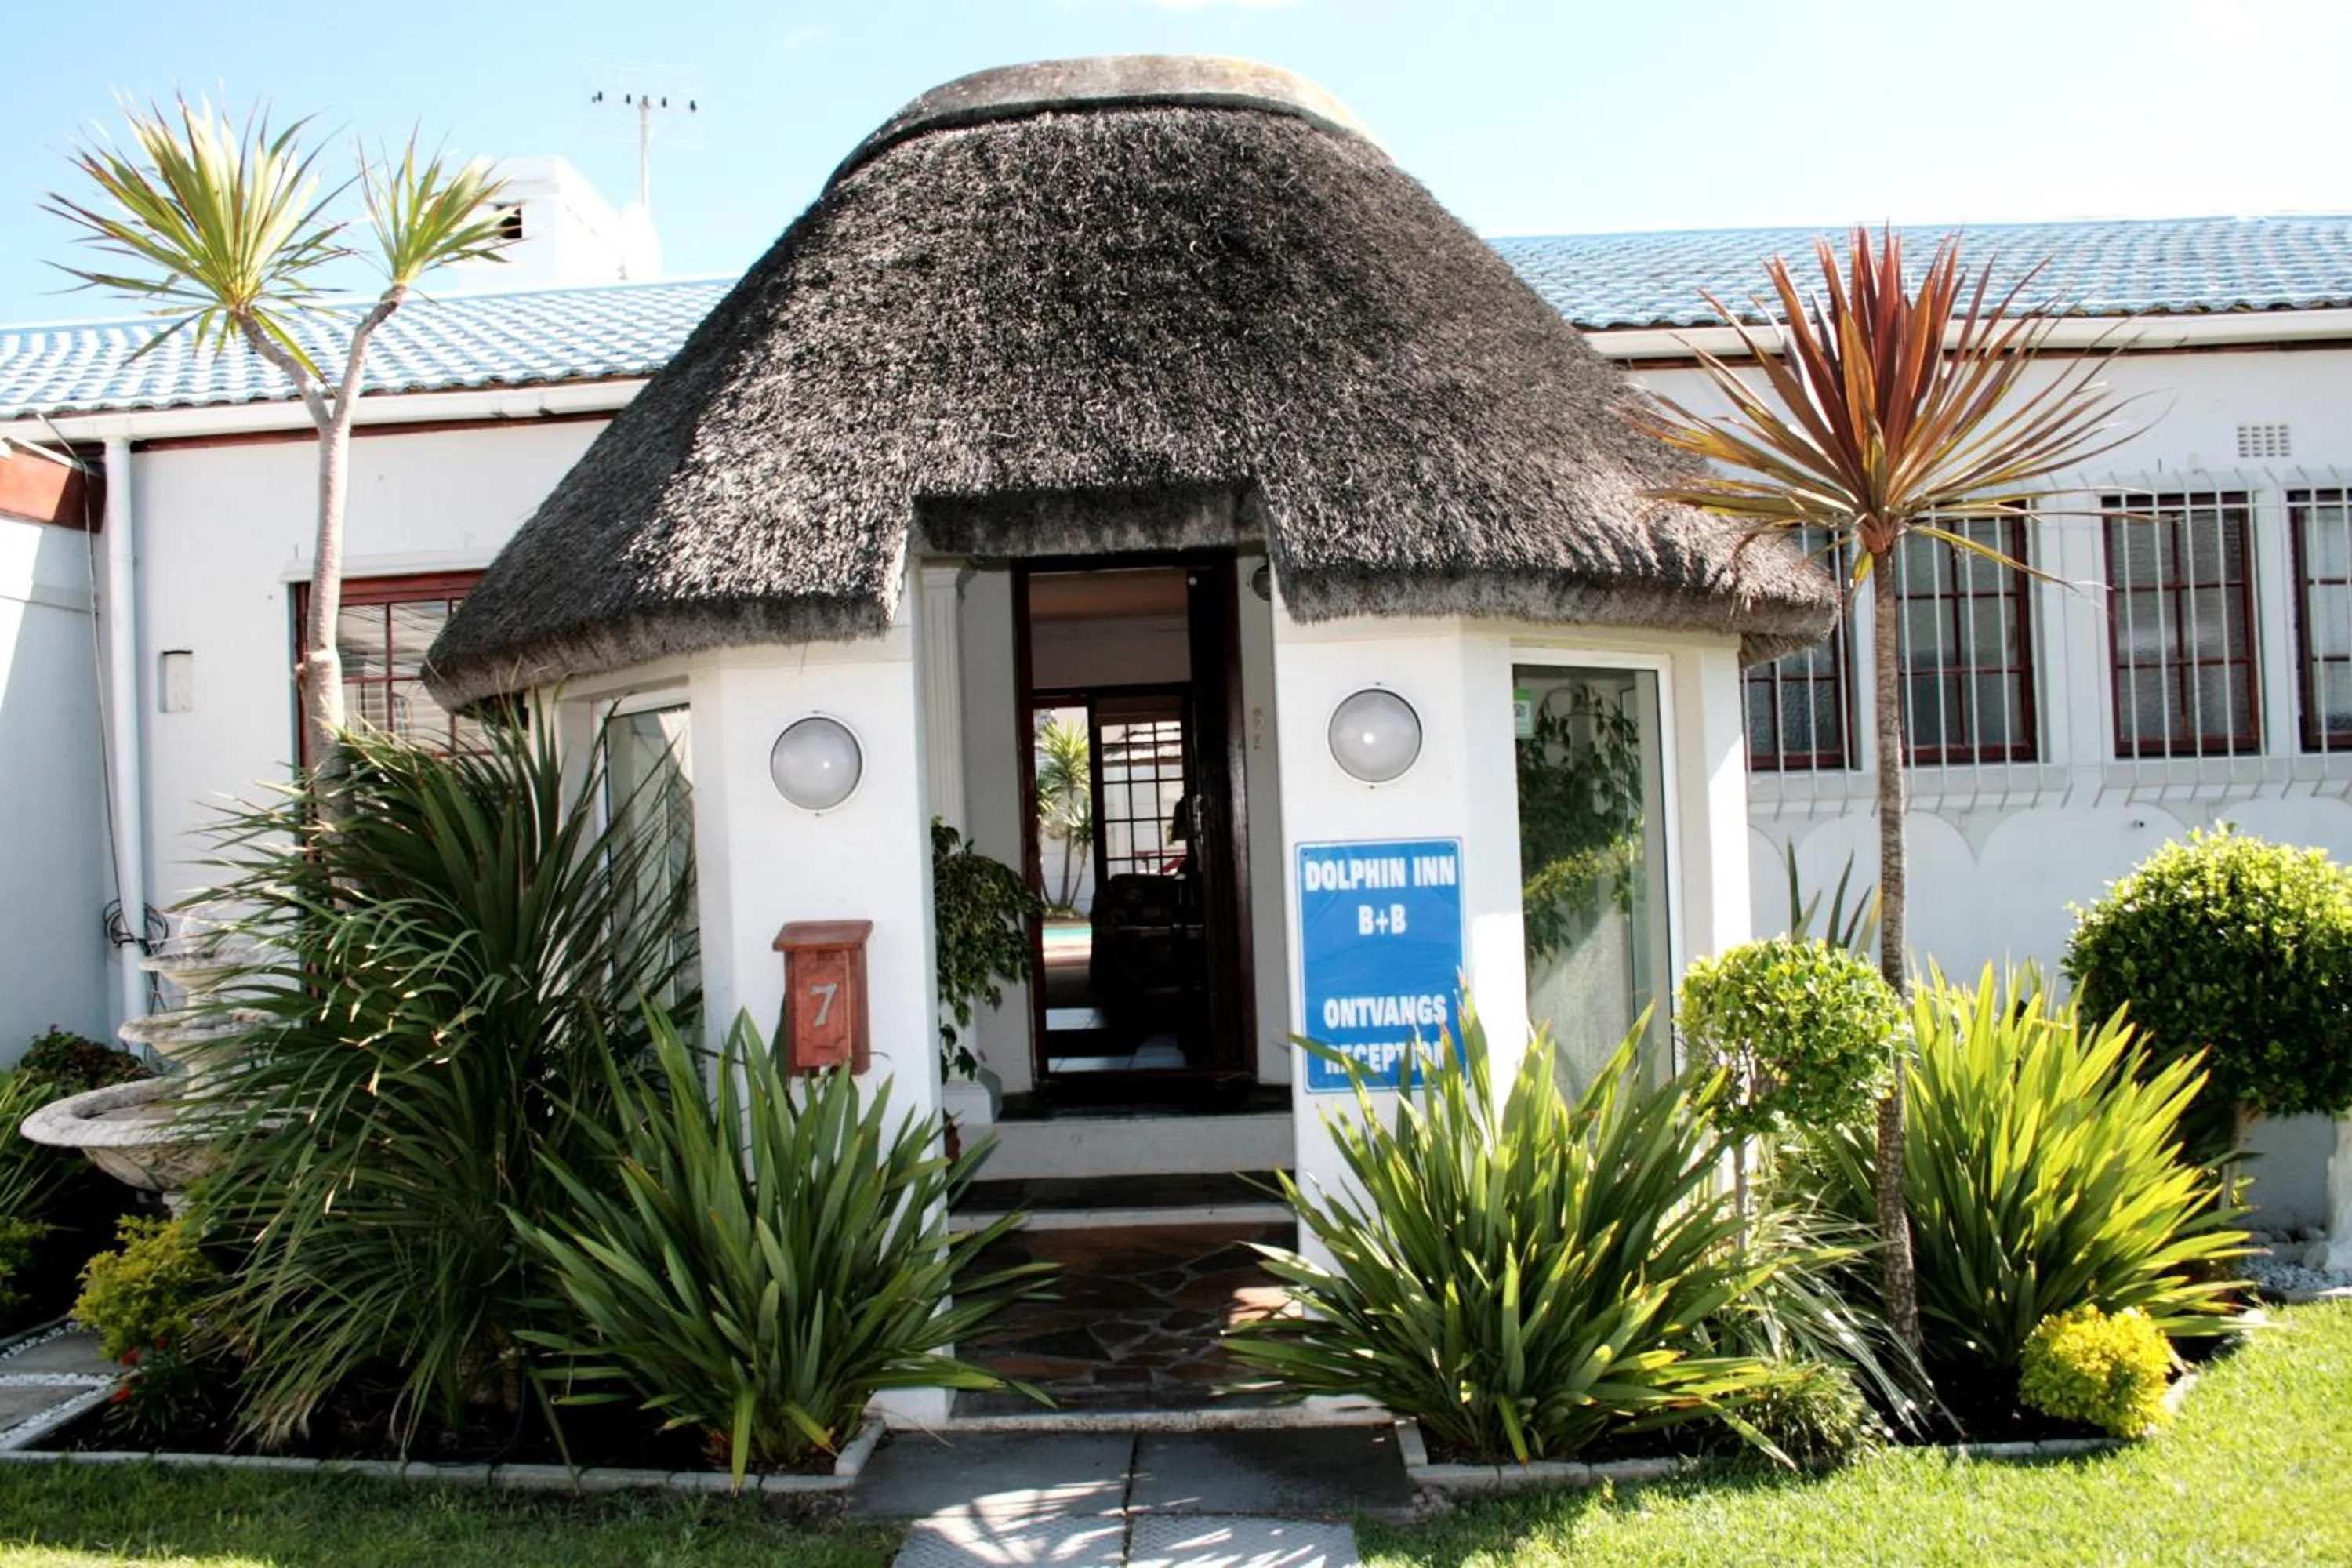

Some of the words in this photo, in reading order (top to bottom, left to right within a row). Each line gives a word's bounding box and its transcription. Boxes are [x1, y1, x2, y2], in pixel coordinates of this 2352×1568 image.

[1305, 858, 1406, 891] DOLPHIN
[1413, 855, 1456, 887] INN
[1358, 903, 1406, 935] B+B
[809, 982, 838, 1029] 7
[1323, 994, 1448, 1029] ONTVANGS
